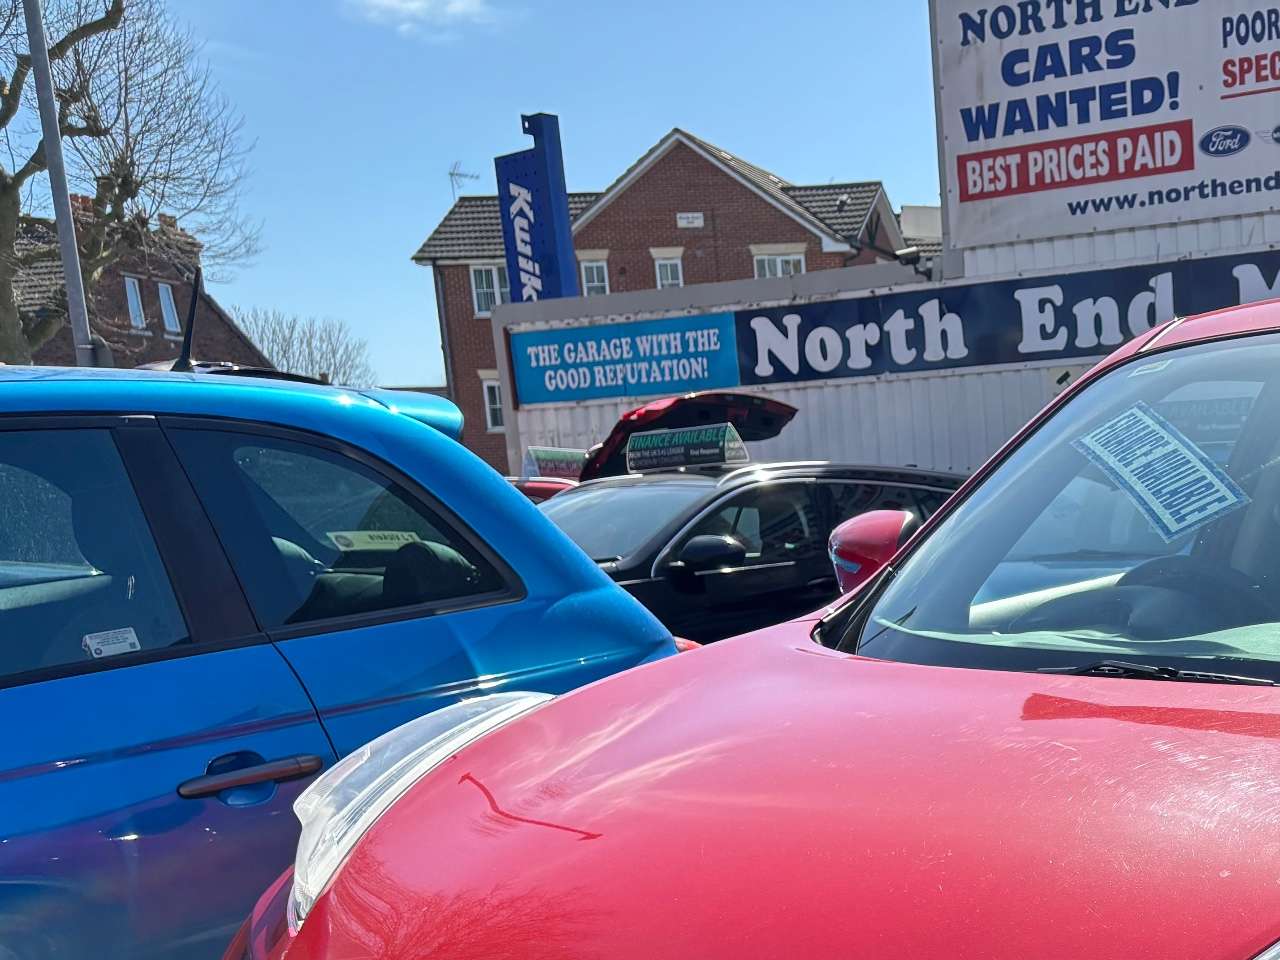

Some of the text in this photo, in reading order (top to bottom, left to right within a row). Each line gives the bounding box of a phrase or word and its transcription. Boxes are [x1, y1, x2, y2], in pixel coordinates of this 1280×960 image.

[958, 0, 1103, 46] NORTH
[1222, 14, 1280, 48] POOR
[1001, 28, 1136, 87] CARS
[960, 71, 1179, 142] WANTED!
[966, 129, 1182, 195] BEST PRICES PAID
[1209, 131, 1240, 152] Ford
[750, 299, 968, 377] North
[1014, 272, 1174, 352] End
[527, 328, 720, 368] THE GARAGE WITH THE
[544, 357, 708, 391] GOOD REPUTATION!
[630, 426, 725, 448] FINANCE AVAILABLE
[1092, 413, 1229, 524] FINANCE AVAILABLE
